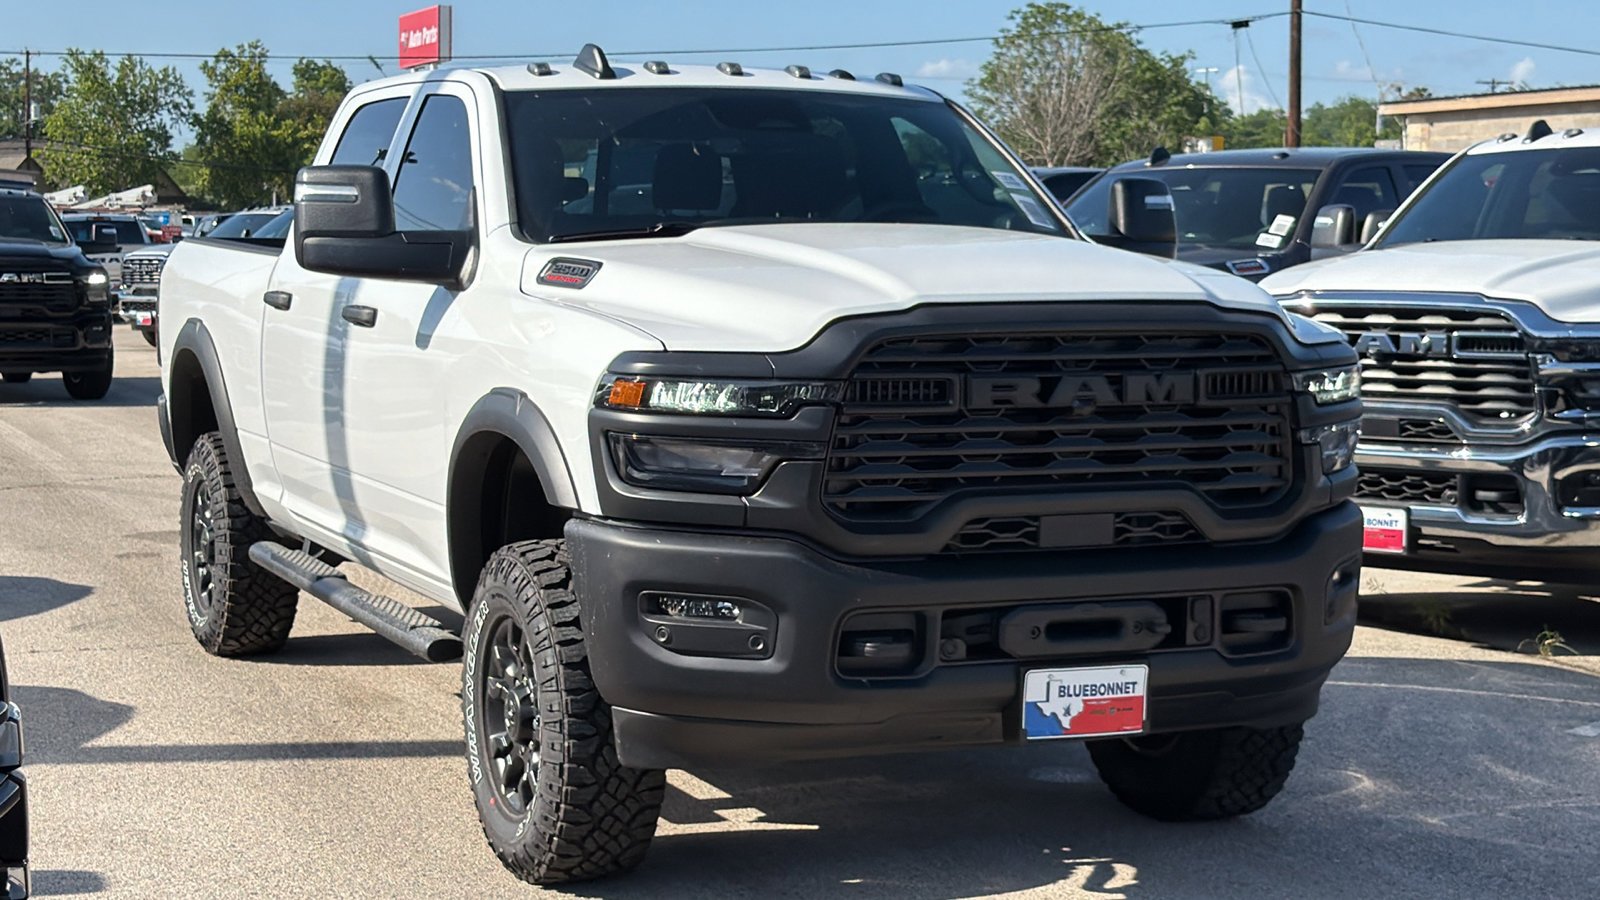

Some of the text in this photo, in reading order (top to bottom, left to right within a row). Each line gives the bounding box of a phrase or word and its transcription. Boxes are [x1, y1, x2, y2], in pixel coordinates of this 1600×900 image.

[0, 272, 43, 283] AM
[1353, 332, 1447, 356] AM
[968, 374, 1195, 408] RAM
[1366, 518, 1399, 527] BONNET
[464, 599, 489, 785] WRANGLER
[1058, 681, 1138, 698] BLUEBONNET
